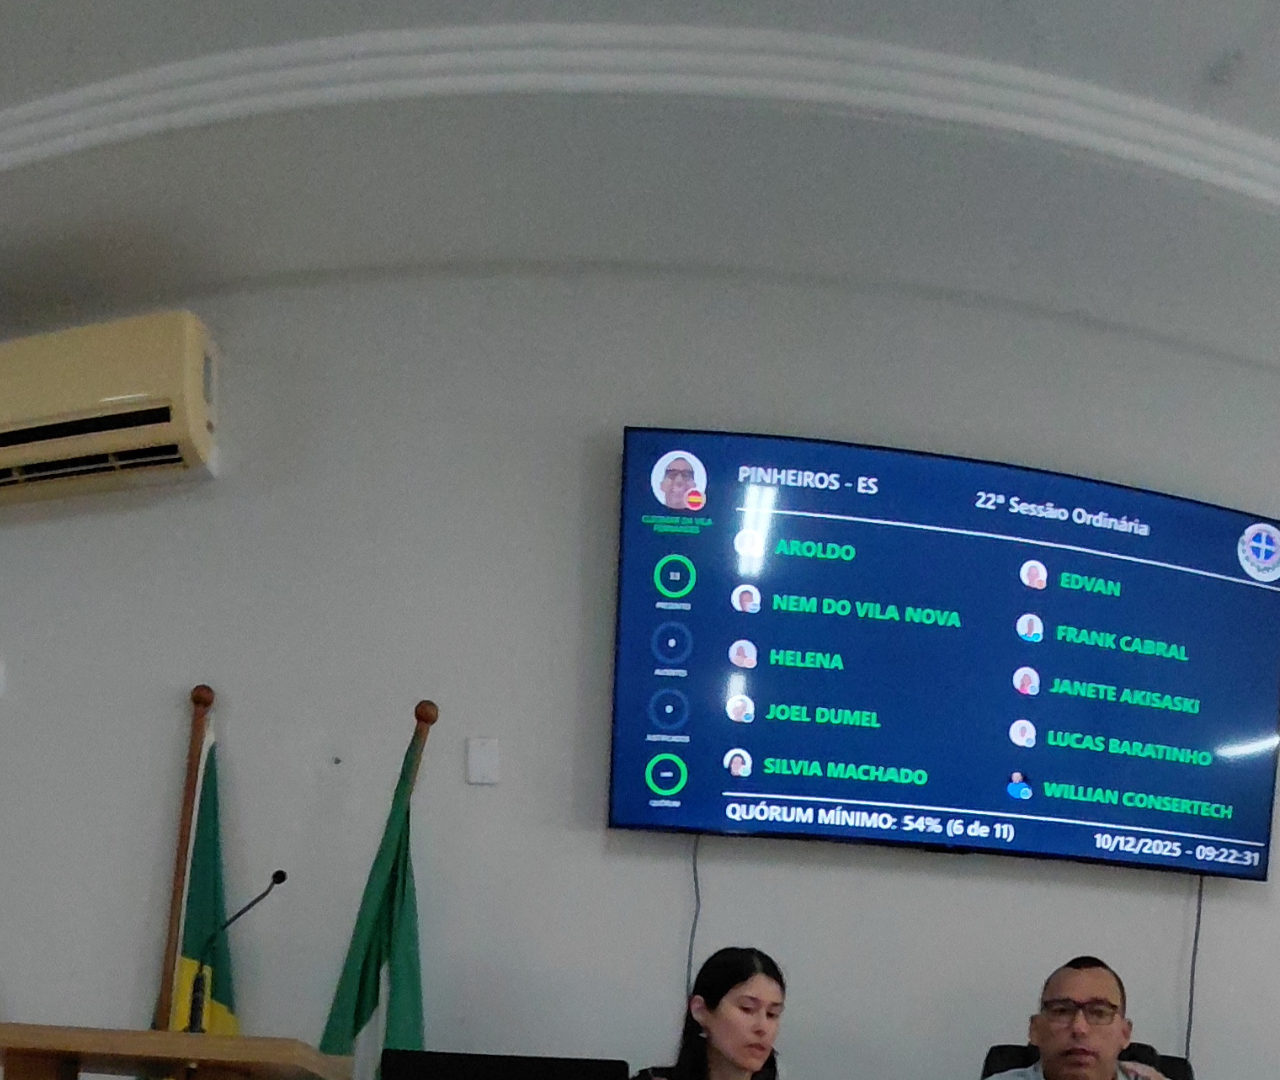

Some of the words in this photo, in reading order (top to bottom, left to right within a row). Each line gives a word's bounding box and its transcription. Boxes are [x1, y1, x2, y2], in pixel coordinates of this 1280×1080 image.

[738, 466, 840, 490] PINHEIROS
[857, 477, 878, 494] ES
[975, 492, 1005, 510] 22ª
[1009, 497, 1069, 522] Sessão
[1073, 508, 1150, 537] Ordinária
[775, 539, 856, 561] AROLDO
[1059, 572, 1121, 597] EDVAN
[772, 594, 817, 613] NEM
[822, 598, 851, 616] DO
[855, 601, 900, 621] VILA
[905, 607, 961, 628] NOVA
[770, 648, 845, 670] HELENA
[1056, 625, 1117, 650] FRANK
[1120, 635, 1189, 662] CABRAL
[1049, 678, 1117, 702] JANETE
[1119, 688, 1200, 715] AKISASKI
[765, 703, 811, 722] JOEL
[815, 707, 881, 728] DUMEL
[1047, 730, 1105, 752] LUCAS
[1108, 738, 1212, 766] BARATINHO
[763, 757, 823, 777] SILVIA
[826, 762, 928, 785] MACHADO
[1043, 781, 1118, 805] WILLIAN
[1122, 791, 1233, 820] CONSERTECH
[725, 801, 813, 824] QUÓRUM
[818, 805, 897, 830] MÍNIMO:
[901, 815, 943, 833] 54%
[946, 818, 964, 837] (6
[966, 821, 990, 838] de
[992, 823, 1015, 842] 11)
[1093, 833, 1182, 857] 10/12/2025
[1195, 844, 1260, 867] 09:22:31
